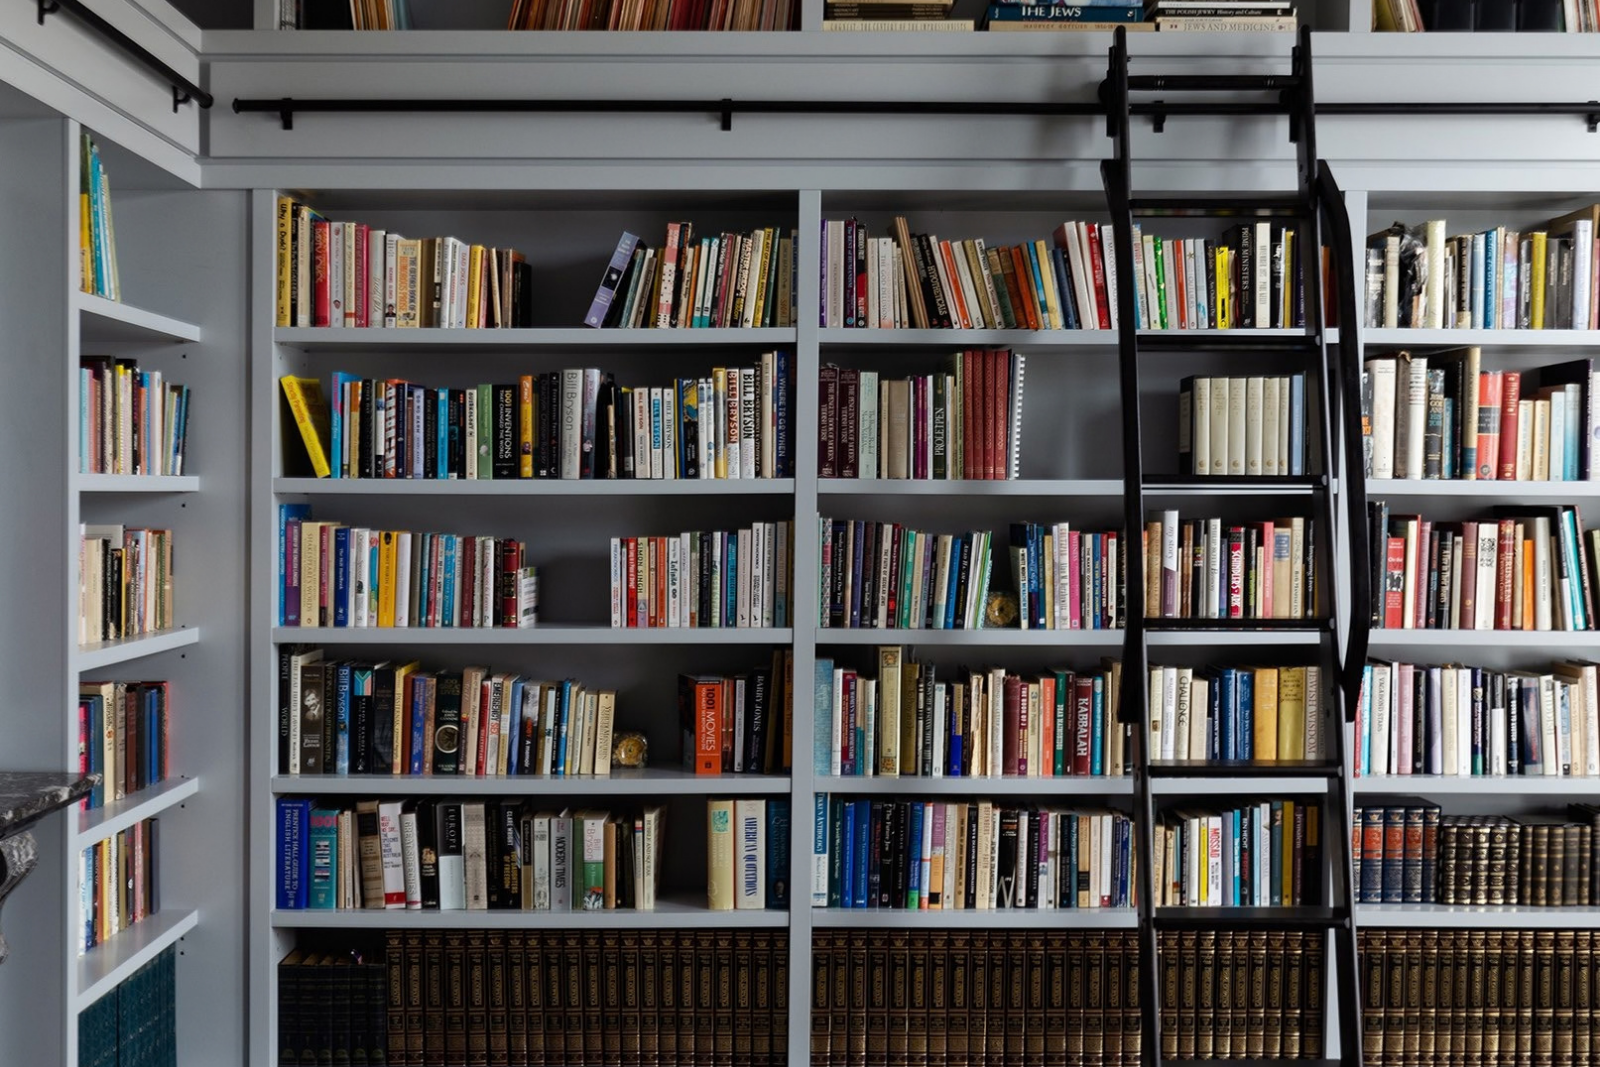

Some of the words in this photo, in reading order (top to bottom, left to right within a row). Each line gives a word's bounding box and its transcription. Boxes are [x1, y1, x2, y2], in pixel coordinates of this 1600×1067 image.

[1048, 7, 1082, 18] JEWS
[1184, 22, 1207, 31] JEWS
[1208, 23, 1223, 31] AND
[1224, 22, 1275, 31] MEDICINE
[927, 265, 947, 315] HYPOTHETICALS
[567, 372, 577, 389] Bill
[728, 372, 738, 398] BILL
[743, 374, 752, 396] BILL
[565, 392, 576, 431] Bryson
[728, 401, 738, 442] BRYSON
[743, 400, 753, 439] BRYSON
[934, 407, 944, 456] PROLETPEN
[1166, 526, 1174, 538] my
[1231, 550, 1240, 589] SCHINDLER'S
[1504, 552, 1513, 602] JERUSALEM
[1231, 594, 1240, 607] ARK
[338, 668, 347, 683] Bill
[755, 676, 764, 703] BARRY
[1308, 670, 1318, 707] JEWISH
[337, 685, 347, 720] Bryson
[491, 682, 502, 721] EMERGENCY
[706, 687, 715, 710] 1001
[1178, 676, 1188, 727] CHALLENGE
[490, 722, 499, 735] SEX
[706, 712, 715, 751] MOVIES
[753, 704, 763, 732] JONES
[1077, 698, 1088, 756] KABBALAH
[1308, 710, 1317, 754] WISDOM
[448, 809, 456, 850] EUROPE
[586, 829, 595, 860] Bryson
[745, 817, 757, 852] AMERICAN
[1210, 828, 1219, 858] MOSSAD
[404, 820, 412, 848] GREAT
[408, 851, 416, 894] SPEECHES
[555, 836, 565, 866] MODERN
[292, 881, 298, 890] TO
[555, 868, 566, 888] TIMES
[743, 855, 757, 897] QUOTATIONS
